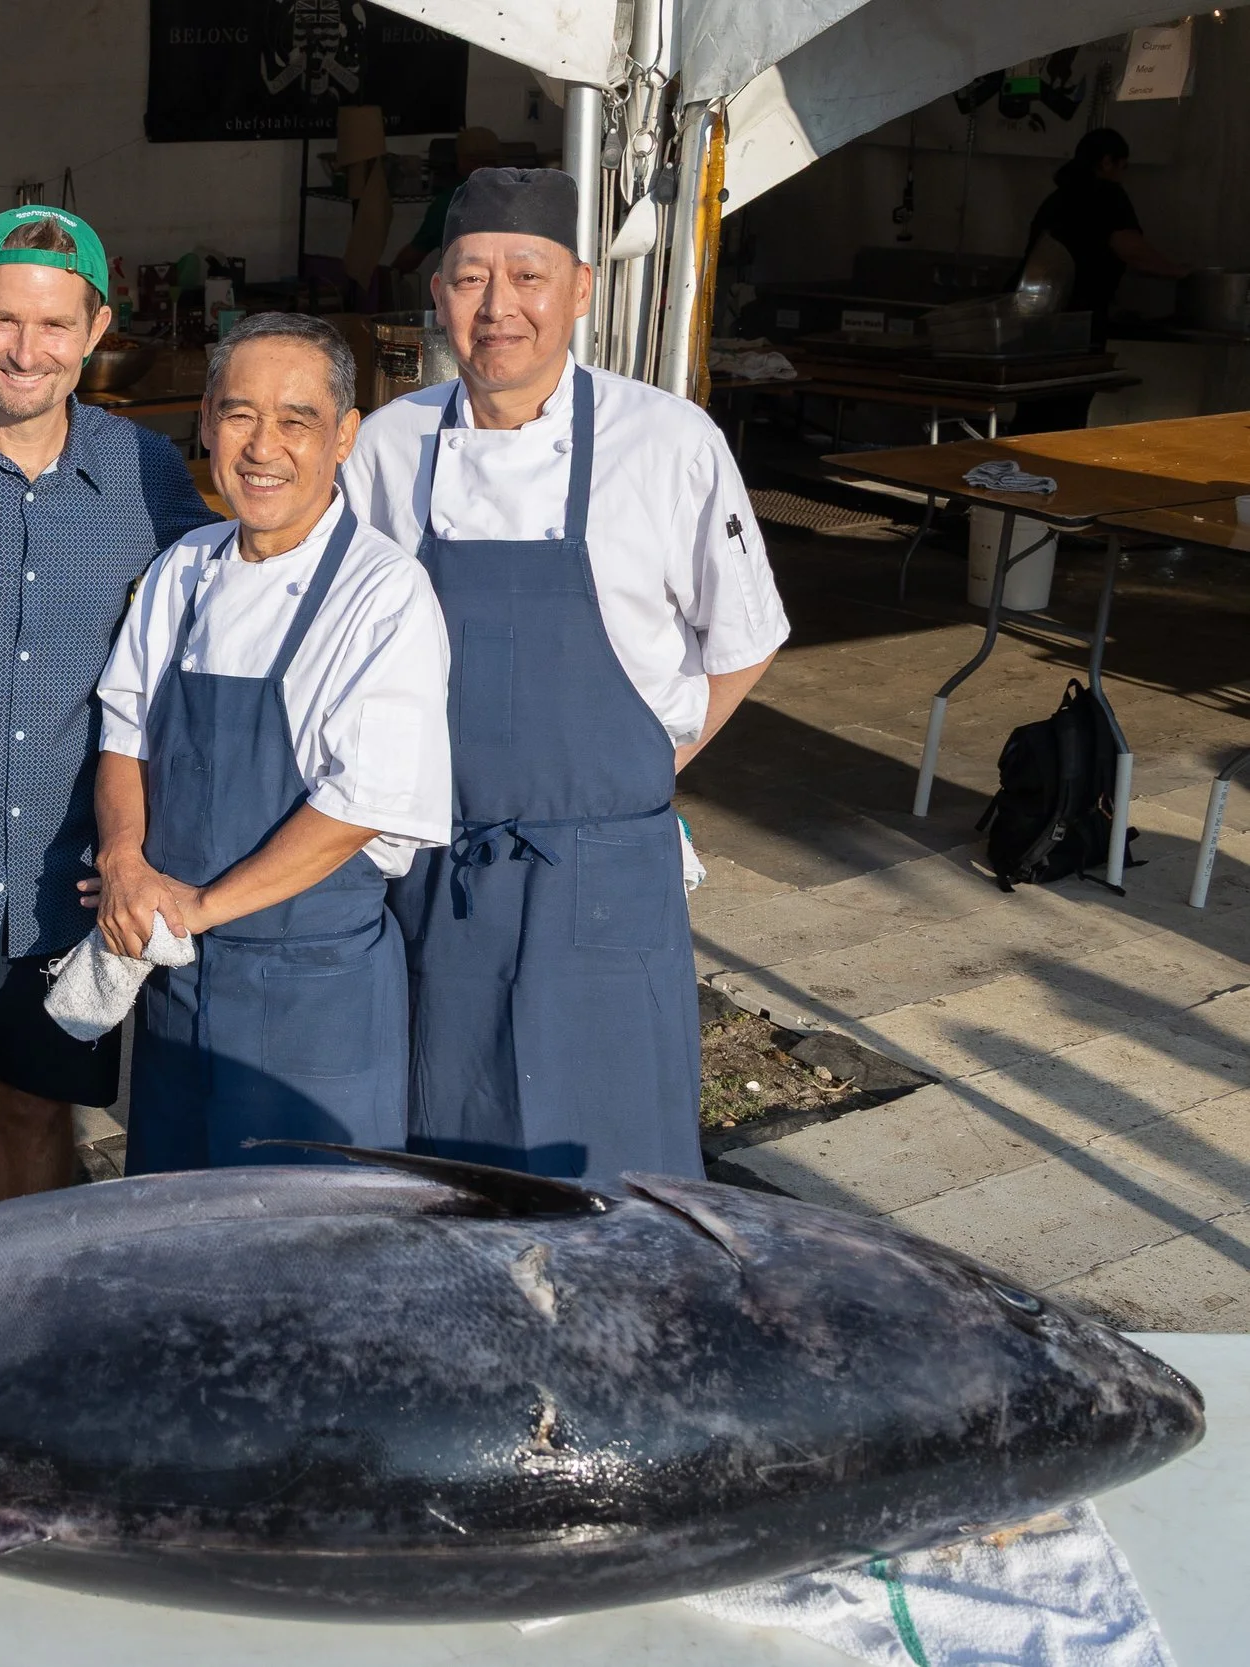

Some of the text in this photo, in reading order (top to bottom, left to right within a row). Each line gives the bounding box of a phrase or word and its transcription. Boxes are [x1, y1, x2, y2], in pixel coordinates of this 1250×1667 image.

[169, 27, 249, 44] BELONG
[1141, 42, 1172, 51] Current
[1135, 65, 1155, 74] Meal
[1127, 86, 1154, 96] Service
